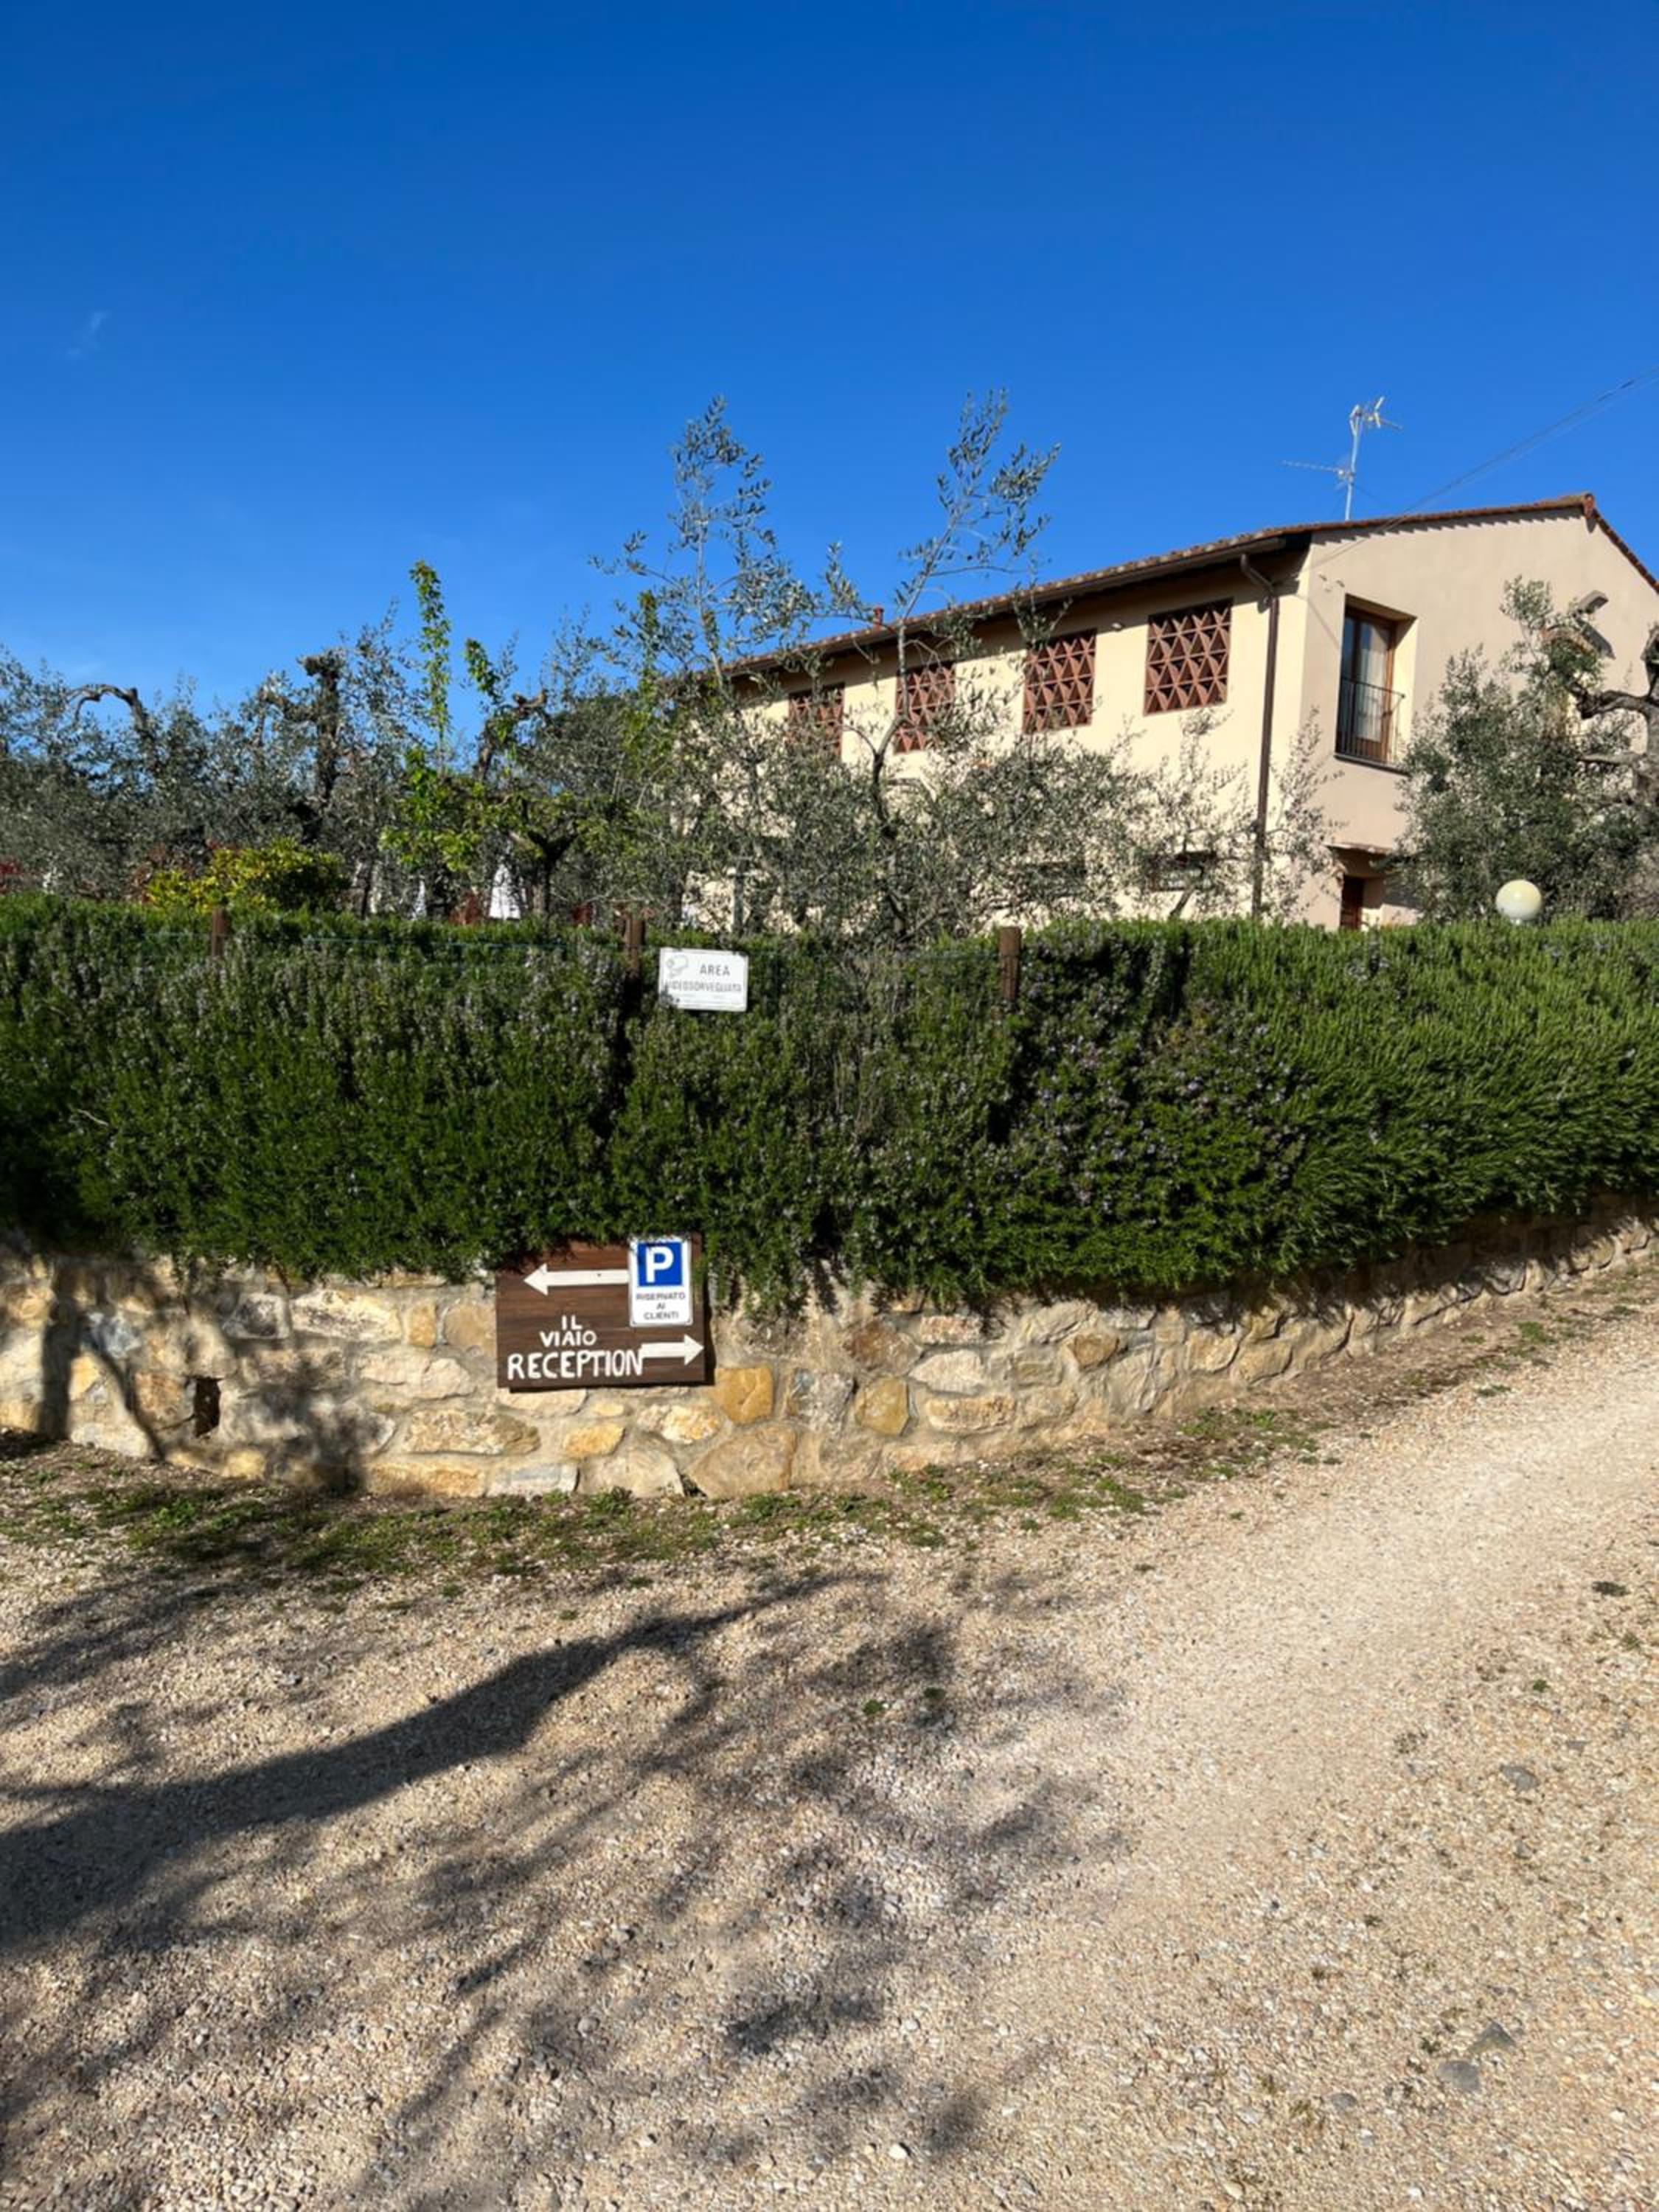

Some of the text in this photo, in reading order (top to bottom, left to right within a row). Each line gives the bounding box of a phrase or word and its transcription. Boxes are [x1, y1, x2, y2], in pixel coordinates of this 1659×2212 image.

[700, 963, 731, 976] AREA
[647, 1246, 674, 1283] P
[636, 1292, 686, 1301] RISERVATO
[656, 1302, 666, 1310] AI
[561, 1315, 583, 1330] IL
[644, 1311, 679, 1320] CLIENTI
[539, 1330, 597, 1347] VIAIO
[507, 1349, 644, 1380] RECEPTION
